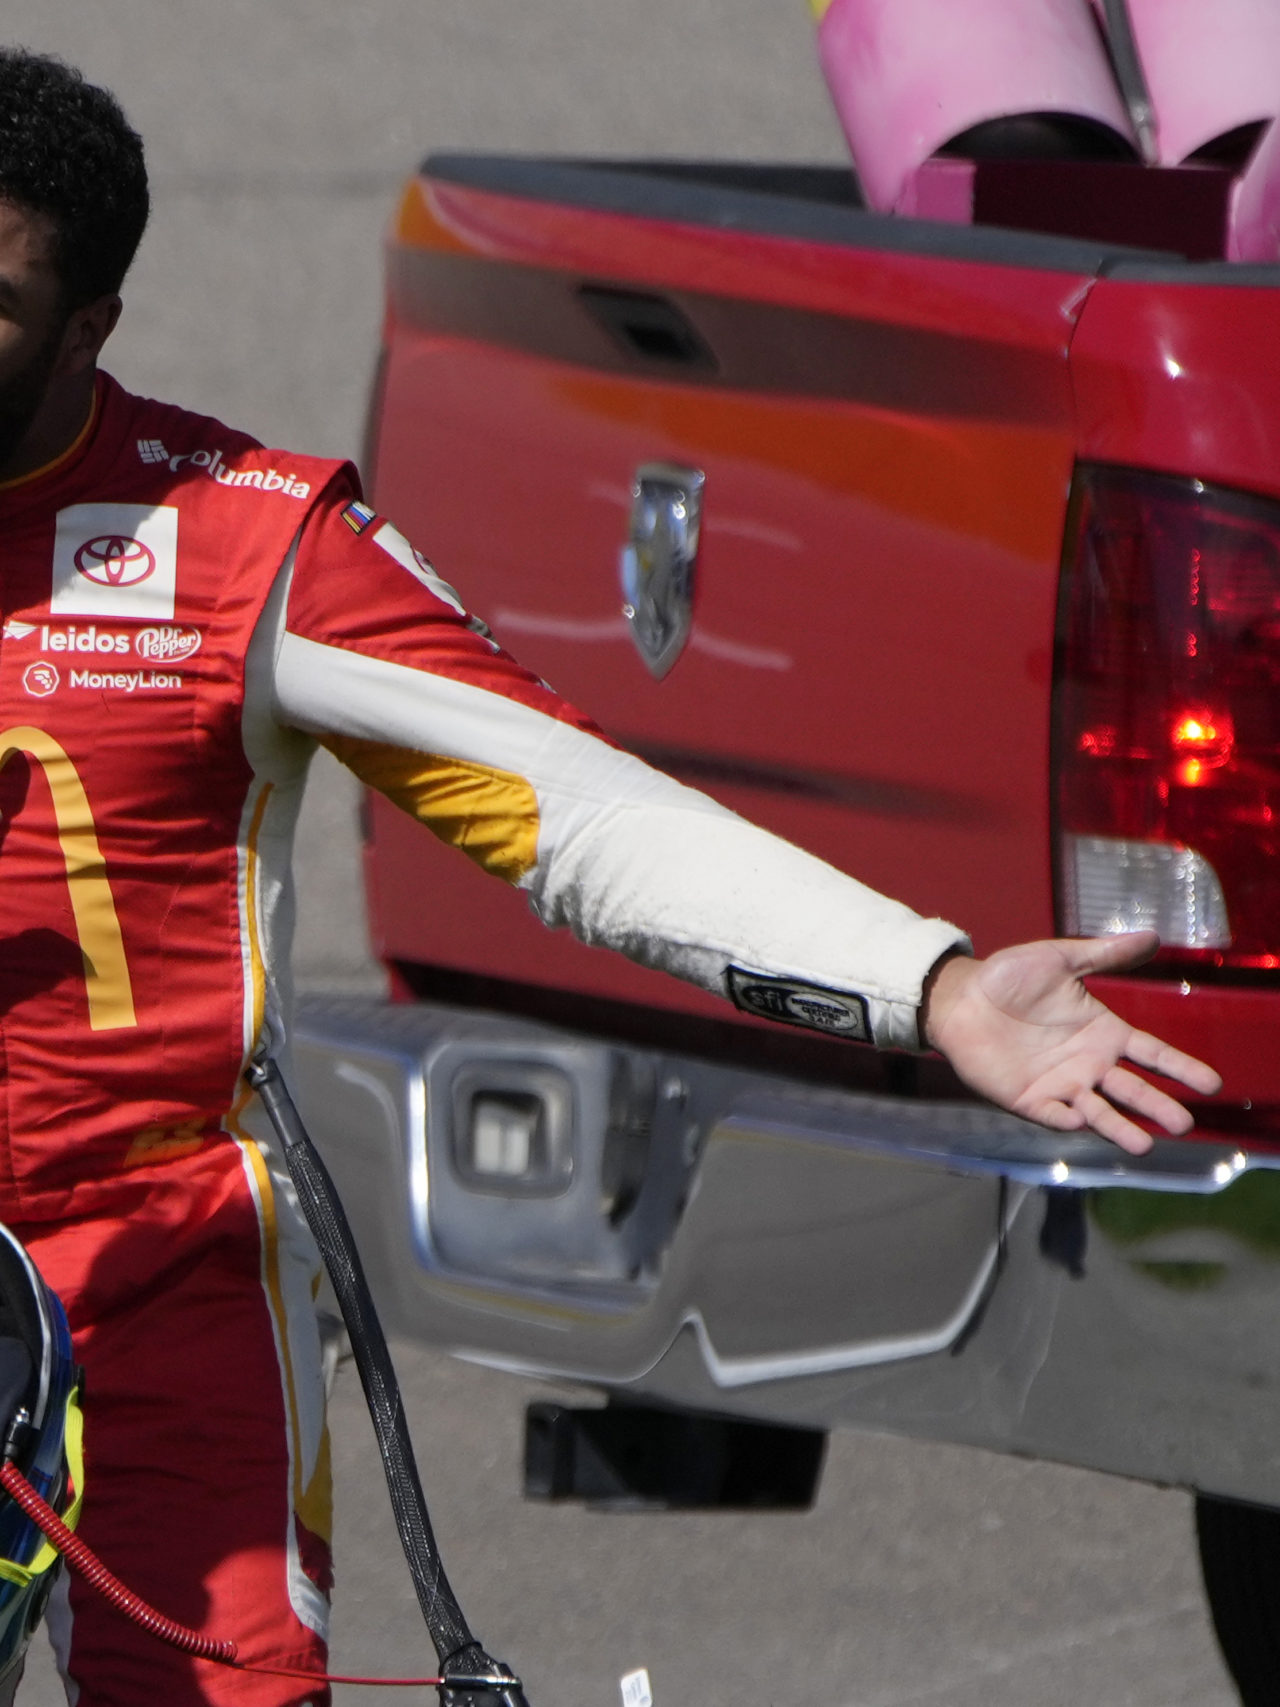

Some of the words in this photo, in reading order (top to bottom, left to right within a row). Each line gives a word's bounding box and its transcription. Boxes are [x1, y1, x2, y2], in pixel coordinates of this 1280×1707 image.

[170, 449, 311, 499] Columbia
[41, 625, 130, 653] leidos
[136, 628, 197, 658] Pepper
[160, 626, 183, 642] Dr
[69, 670, 182, 692] MoneyLion
